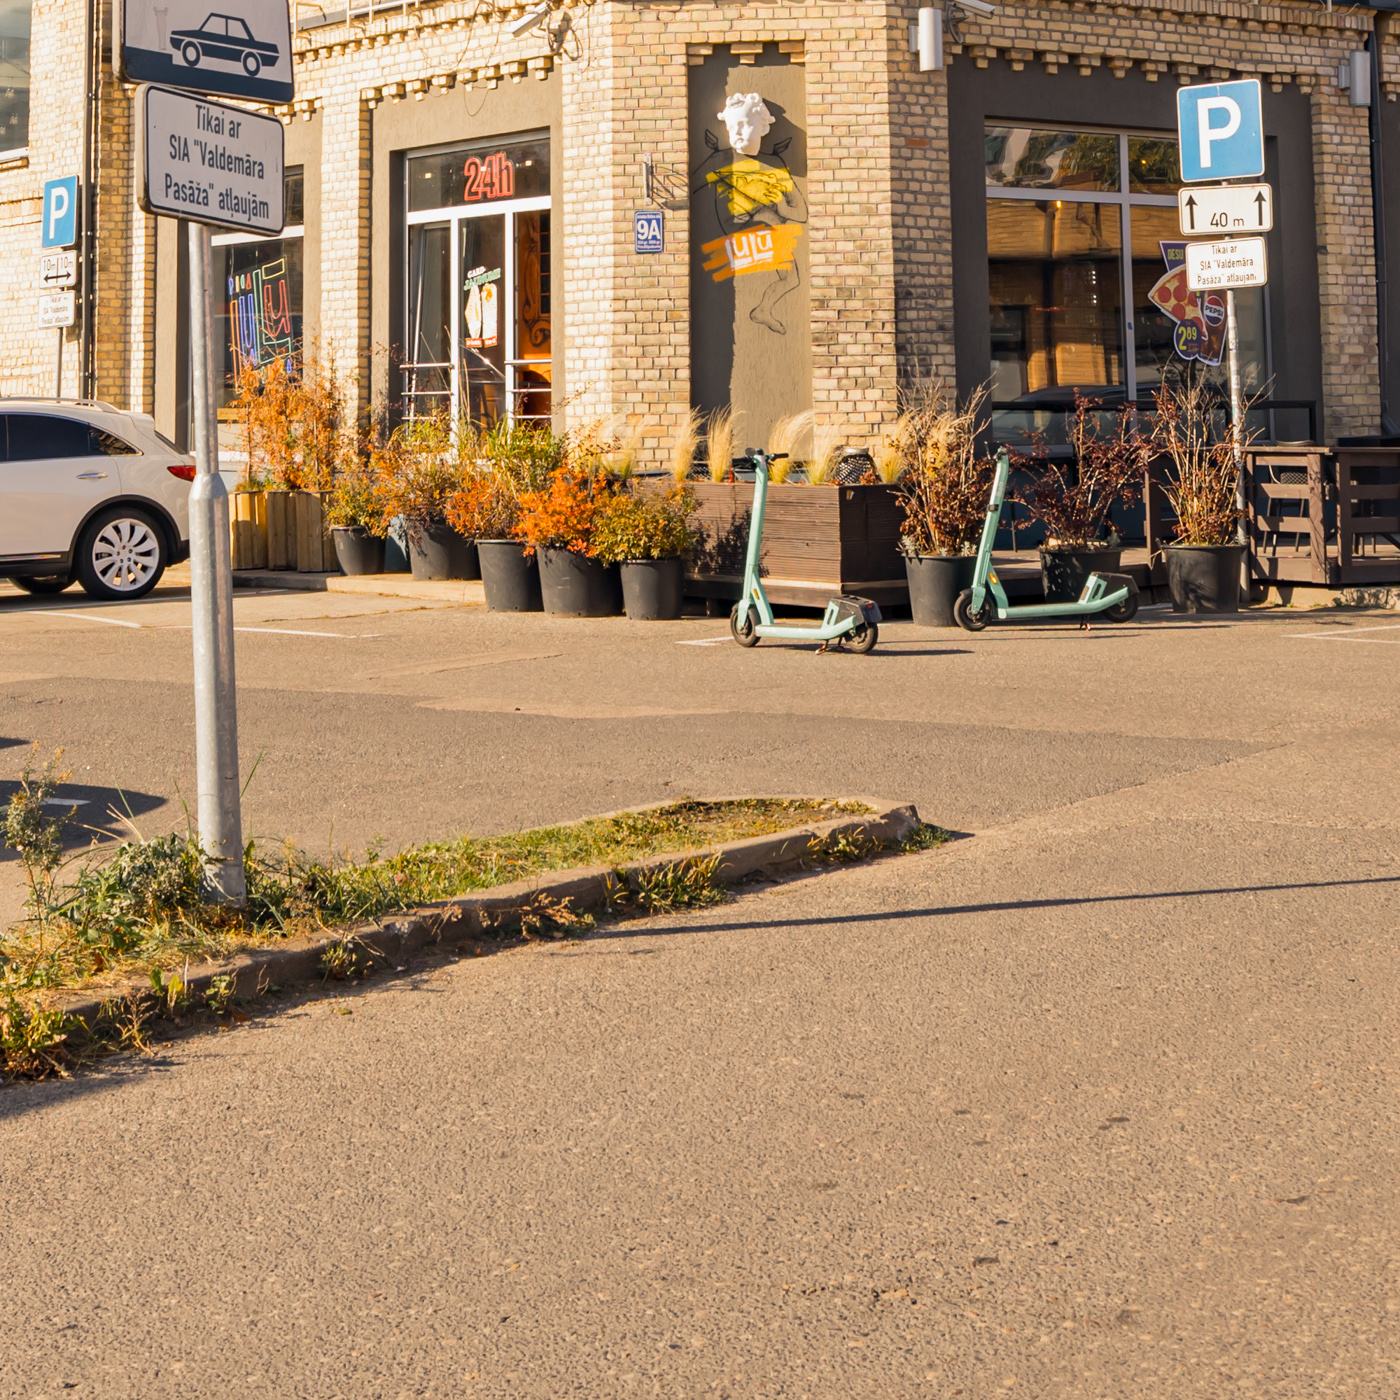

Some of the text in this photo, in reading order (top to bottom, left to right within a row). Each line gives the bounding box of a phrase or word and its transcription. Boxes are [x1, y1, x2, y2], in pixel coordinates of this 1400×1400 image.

[196, 104, 241, 139] Tikai ar
[1198, 96, 1241, 168] P
[170, 134, 264, 180] SIA "Valdemāra
[464, 153, 514, 201] 24h
[49, 186, 69, 240] P
[165, 173, 269, 222] Pasāža" atļaujām
[637, 219, 661, 240] 9A
[1210, 212, 1245, 228] 40 m
[1200, 260, 1212, 271] SIA
[1204, 304, 1225, 317] PEPSI
